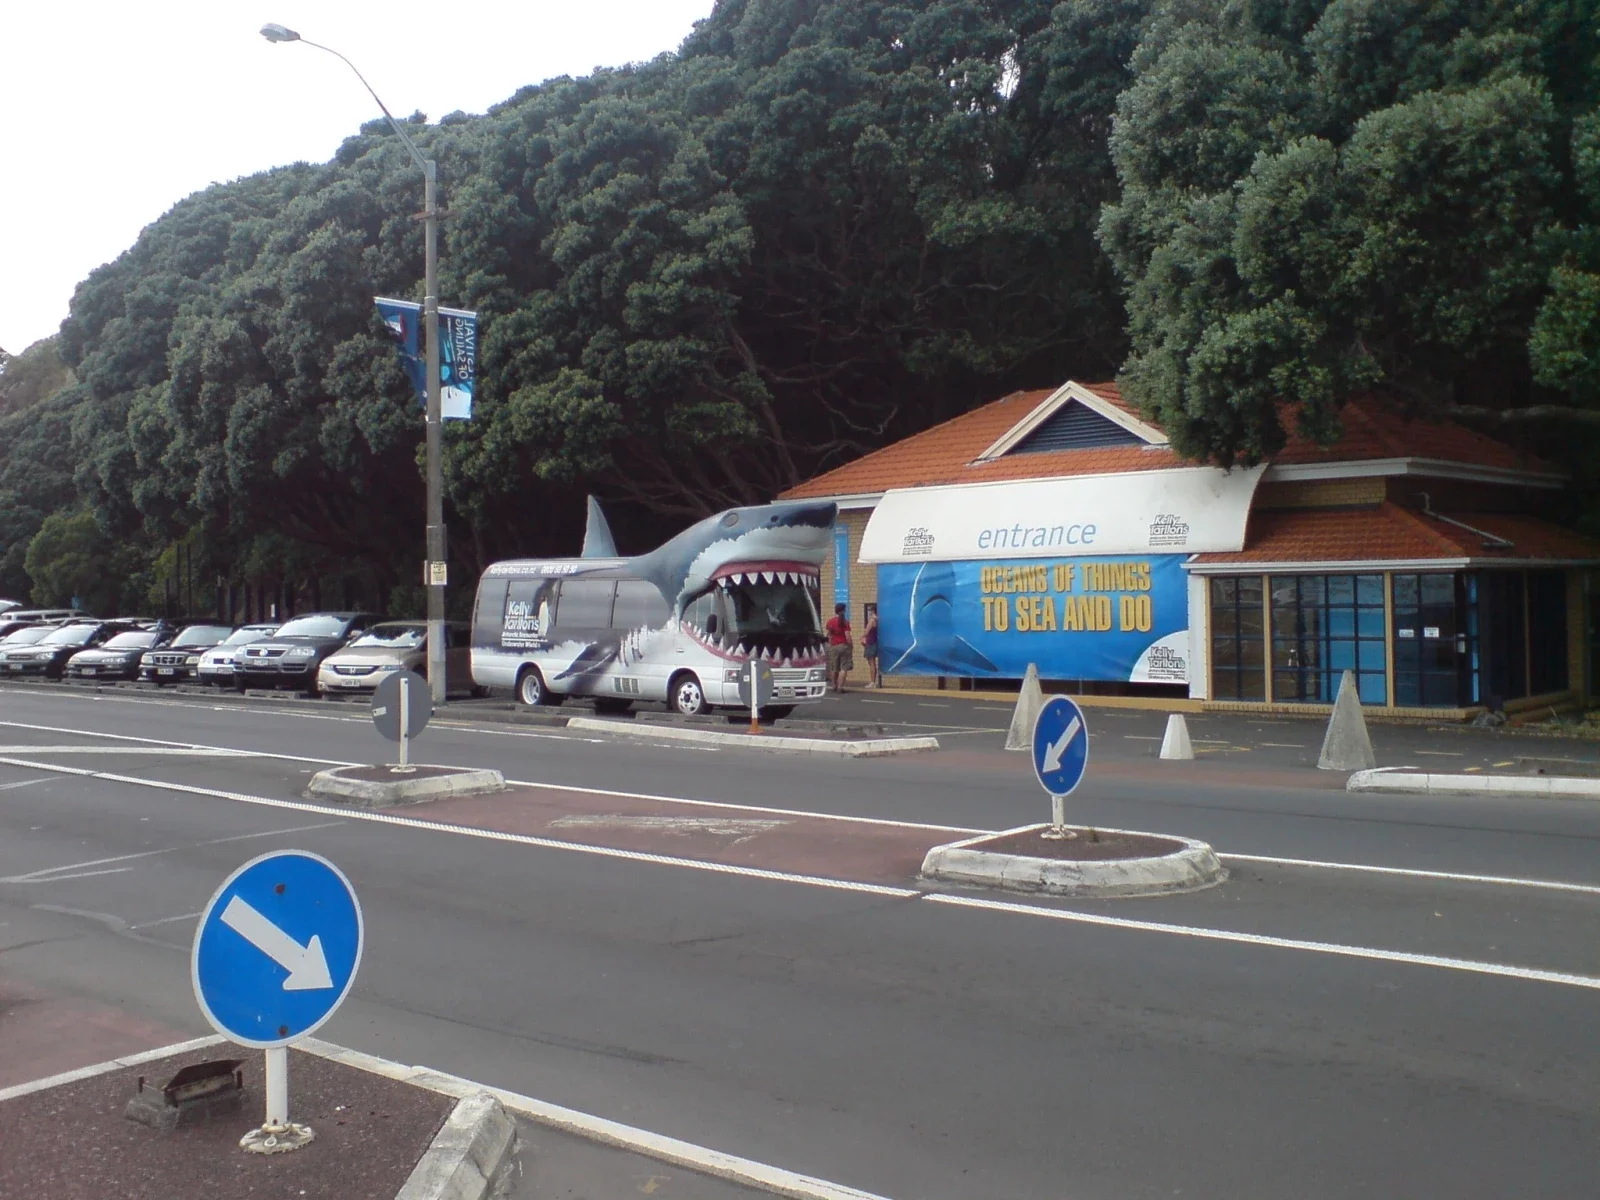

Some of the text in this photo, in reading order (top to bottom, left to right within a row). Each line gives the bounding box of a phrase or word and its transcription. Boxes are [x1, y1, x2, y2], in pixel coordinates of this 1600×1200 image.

[978, 523, 1097, 549] entrance
[981, 561, 1151, 594] OCEANS OF THINGS
[508, 601, 530, 620] Kelly
[981, 595, 1152, 632] TO SEA AND DO
[1150, 646, 1174, 660] Kelly
